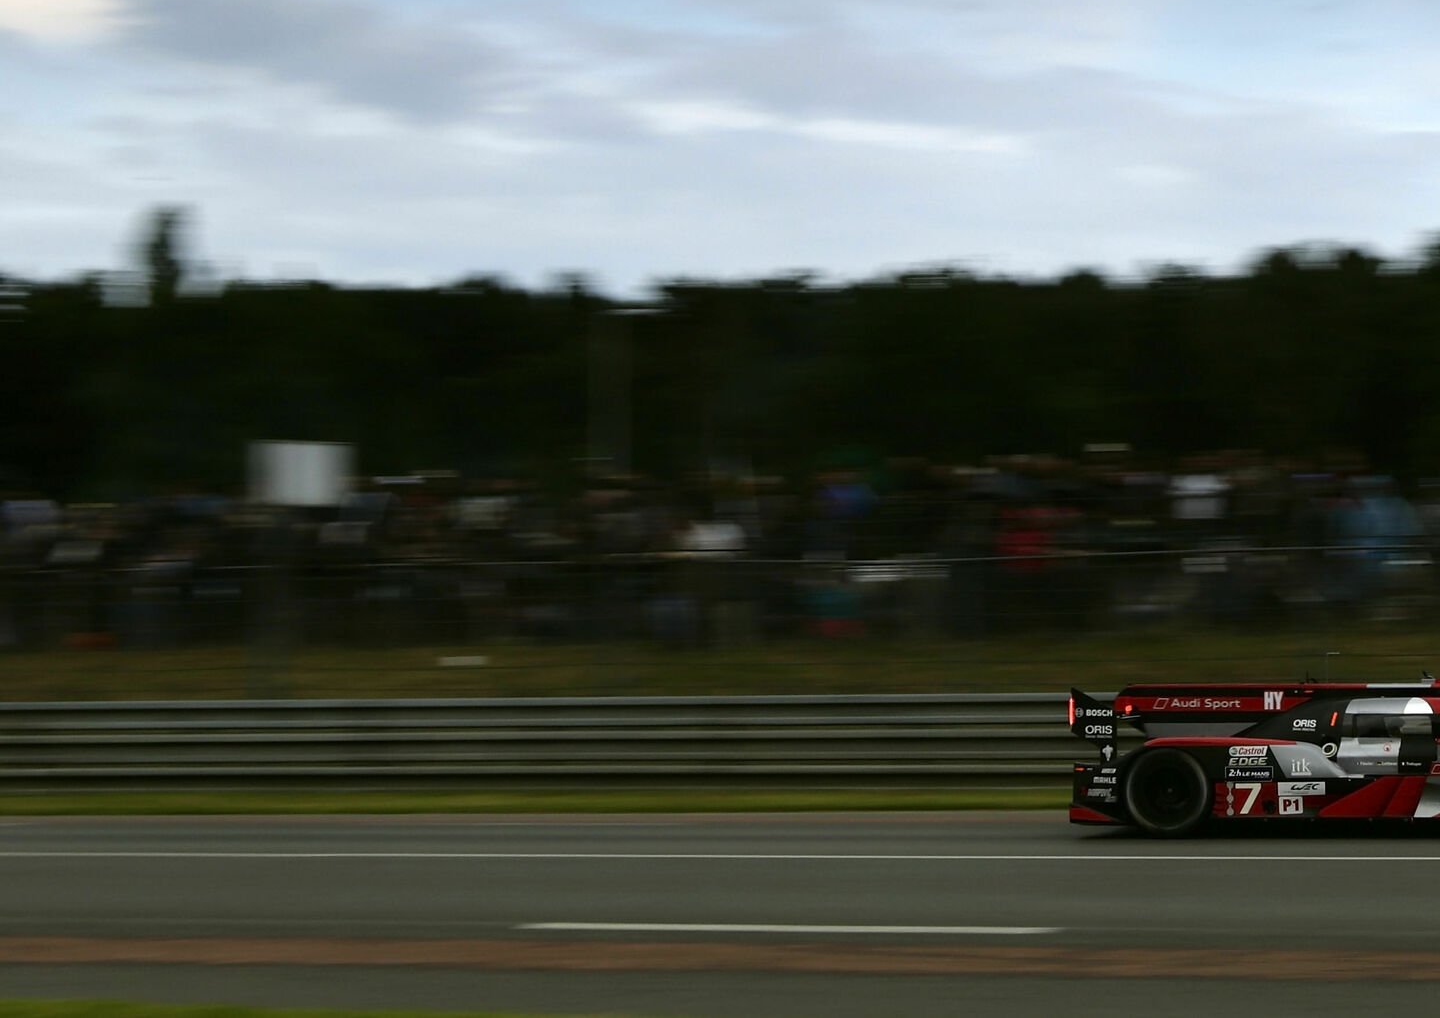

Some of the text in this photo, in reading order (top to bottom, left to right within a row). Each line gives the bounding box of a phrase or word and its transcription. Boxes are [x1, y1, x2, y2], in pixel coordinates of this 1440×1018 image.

[1170, 698, 1241, 710] Audi Sport
[1263, 691, 1284, 710] HY
[1085, 709, 1113, 717] BOSCH
[1292, 719, 1317, 728] ORIS
[1085, 725, 1113, 735] ORIS
[1238, 747, 1265, 756] Castrol
[1228, 757, 1268, 766] EDGE
[1235, 783, 1262, 814] 7
[1282, 798, 1300, 812] P1
